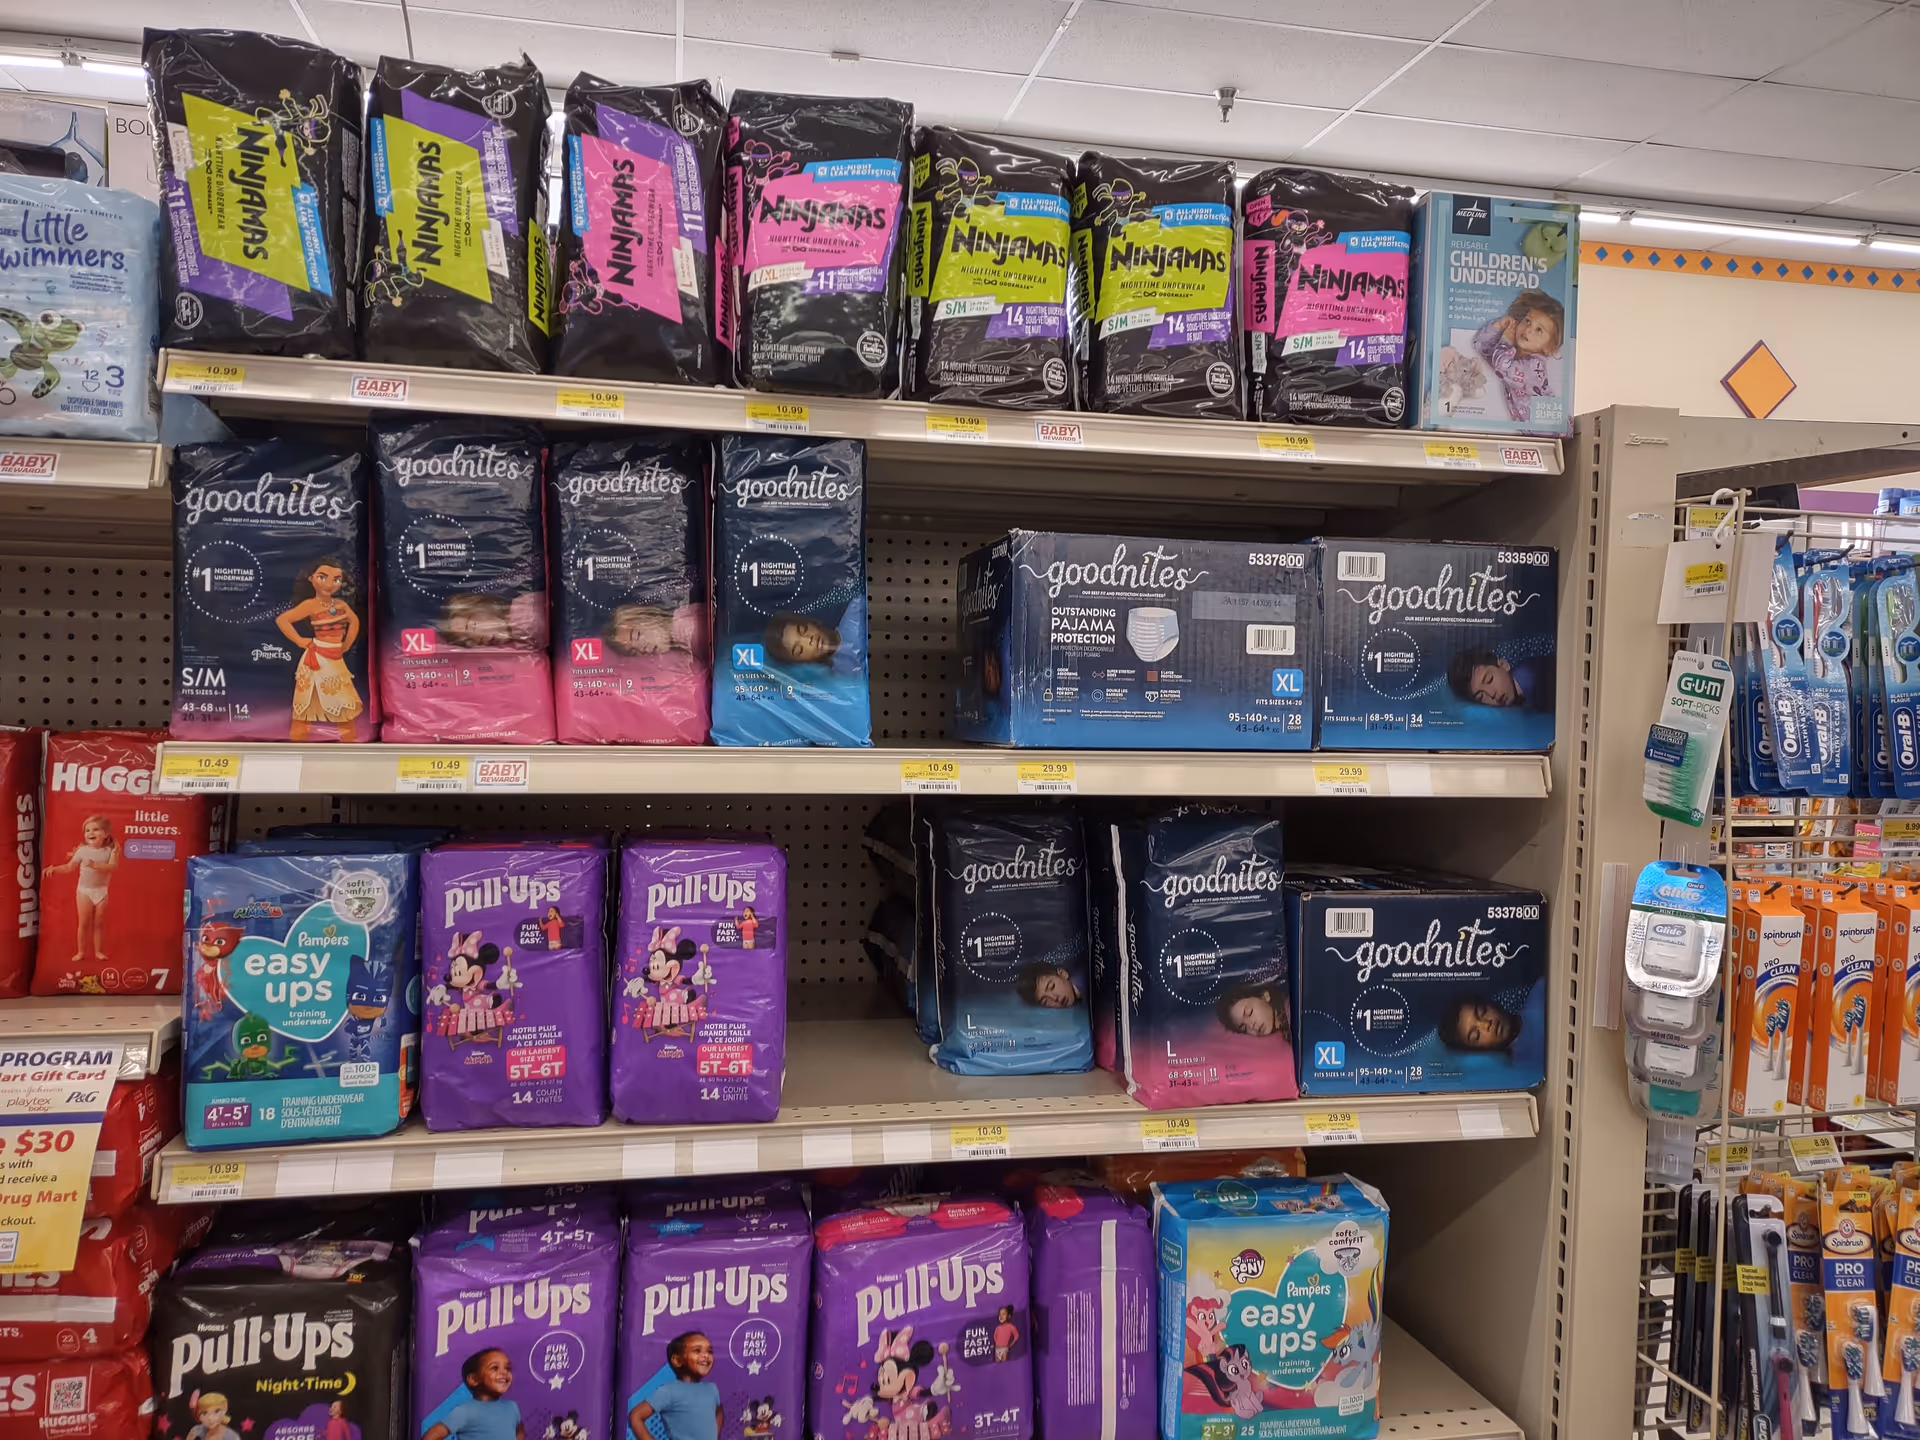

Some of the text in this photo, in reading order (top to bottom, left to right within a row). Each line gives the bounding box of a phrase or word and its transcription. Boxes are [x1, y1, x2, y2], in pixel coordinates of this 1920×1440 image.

[229, 127, 269, 260] NINJAMAS
[412, 141, 450, 267] NINJAMAS
[760, 195, 886, 232] NINJAMAS
[1177, 207, 1213, 215] ALL-NIGHT
[1456, 210, 1488, 219] MEDLINE
[22, 210, 88, 244] Little
[607, 159, 643, 287] NINJAMAS
[683, 213, 703, 232] 11
[912, 207, 926, 288] NINJAMAS
[951, 225, 1066, 267] NINJAMAS
[1451, 240, 1490, 250] REUSABLE
[0, 247, 128, 272] wimmers.
[1110, 241, 1227, 277] NINJAMAS
[1450, 250, 1548, 273] CHILDREN'S
[532, 236, 546, 322] NINJAMAS
[754, 268, 778, 284] L/XL
[818, 271, 834, 290] 11
[961, 266, 1047, 285] NIGHTTIME UNDERWEAR
[1297, 264, 1405, 300] NINJAMAS
[1450, 266, 1540, 289] UNDERPAD
[1251, 246, 1269, 323] NINJAMAS
[946, 302, 967, 315] S/M
[1006, 306, 1024, 326] 14
[1108, 316, 1128, 331] S/M
[1166, 316, 1184, 334] 14
[1349, 340, 1365, 359] 14
[84, 370, 99, 380] 12
[105, 366, 124, 388] 3
[954, 417, 980, 426] 10.99
[1535, 410, 1563, 420] SUPER
[1040, 425, 1077, 436] BABY
[1449, 446, 1469, 454] 9.99
[1504, 450, 1537, 461] BABY
[397, 444, 520, 487] goodnites
[568, 462, 682, 506] goodnites
[736, 464, 850, 508] goodnites
[185, 472, 345, 525] goodnites
[1248, 553, 1304, 568] 5337800
[1497, 551, 1549, 566] 5335900
[760, 562, 796, 570] NIGHTTIME
[1047, 543, 1196, 598] goodnites
[1708, 564, 1724, 574] 7.49
[741, 562, 758, 587] #1
[1367, 564, 1521, 625] goodnites
[1052, 607, 1116, 617] OUTSTANDING
[1052, 618, 1115, 631] PAJAMA
[1051, 633, 1116, 644] PROTECTION
[736, 648, 761, 666] XL
[182, 667, 226, 687] S/M
[462, 670, 470, 679] 9
[626, 680, 632, 689] 9
[1276, 674, 1299, 691] XL
[1324, 696, 1333, 712] L
[1671, 697, 1720, 715] SOFT-PICKS
[1288, 714, 1302, 725] 28
[1410, 714, 1423, 723] 34
[1682, 709, 1707, 719] ORIGINAL
[1897, 714, 1914, 765] Oral-B
[198, 758, 228, 768] 10.49
[1042, 764, 1068, 773] 29.99
[478, 763, 524, 777] BABY
[1339, 767, 1363, 776] 29.99
[480, 776, 521, 784] REWARDS
[135, 810, 169, 822] little
[124, 823, 181, 836] movers.
[17, 794, 38, 938] HUGGIES
[963, 842, 1077, 894] goodnites
[1163, 854, 1279, 909] goodnites
[1659, 885, 1701, 901] Glide
[1487, 905, 1539, 919] 5337800
[1763, 929, 1801, 941] spinbrush
[1839, 927, 1875, 938] spinbrush
[298, 932, 349, 948] Pampers
[967, 937, 982, 957] #1
[1356, 919, 1510, 983] goodnites
[1184, 953, 1216, 961] NIGHTTIME
[1763, 957, 1780, 969] PRO
[1840, 955, 1856, 966] PRO
[244, 952, 330, 978] easy
[1770, 965, 1796, 976] CLEAN
[1846, 961, 1871, 974] CLEAN
[150, 968, 169, 990] 7
[265, 981, 332, 1008] ups
[289, 1010, 326, 1019] training
[282, 1017, 332, 1027] underwear
[512, 1026, 536, 1034] NOTRE
[507, 1033, 536, 1041] GRANDE
[528, 1047, 560, 1055] LARGEST
[1167, 1041, 1176, 1057] L
[0, 1051, 113, 1067] PROGRAM
[1318, 1047, 1342, 1065] XL
[0, 1070, 107, 1082] art Gift Card
[510, 1062, 563, 1078] 5T-6T
[1410, 1067, 1422, 1076] 28
[65, 1091, 99, 1103] P&G
[536, 1088, 562, 1097] COUNT
[6, 1097, 52, 1107] playtex
[282, 1093, 364, 1106] TRAINING UNDERWEAR
[259, 1108, 275, 1120] 18
[976, 1126, 1002, 1137] 10.49
[14, 1129, 75, 1157] $30
[1814, 1138, 1829, 1147] 8.99
[1732, 1147, 1748, 1155] 8.99
[8, 1159, 33, 1168] with
[208, 1163, 239, 1174] 10.99
[7, 1174, 48, 1183] receive
[37, 1190, 78, 1203] Mart
[1329, 1236, 1363, 1246] comfyFIT
[1831, 1238, 1864, 1249] Spinbrush
[1835, 1262, 1864, 1276] PRO
[1287, 1282, 1331, 1298] Pampers
[1241, 1302, 1315, 1330] easy
[82, 1328, 97, 1343] 4
[966, 1330, 989, 1338] FUN.
[965, 1339, 991, 1348] FAST.
[1259, 1330, 1317, 1358] ups
[964, 1348, 992, 1358] EASY.
[1279, 1359, 1310, 1367] training
[1272, 1366, 1315, 1376] underwear
[275, 1425, 315, 1434] ABSORBS
[1241, 1426, 1255, 1436] 25
